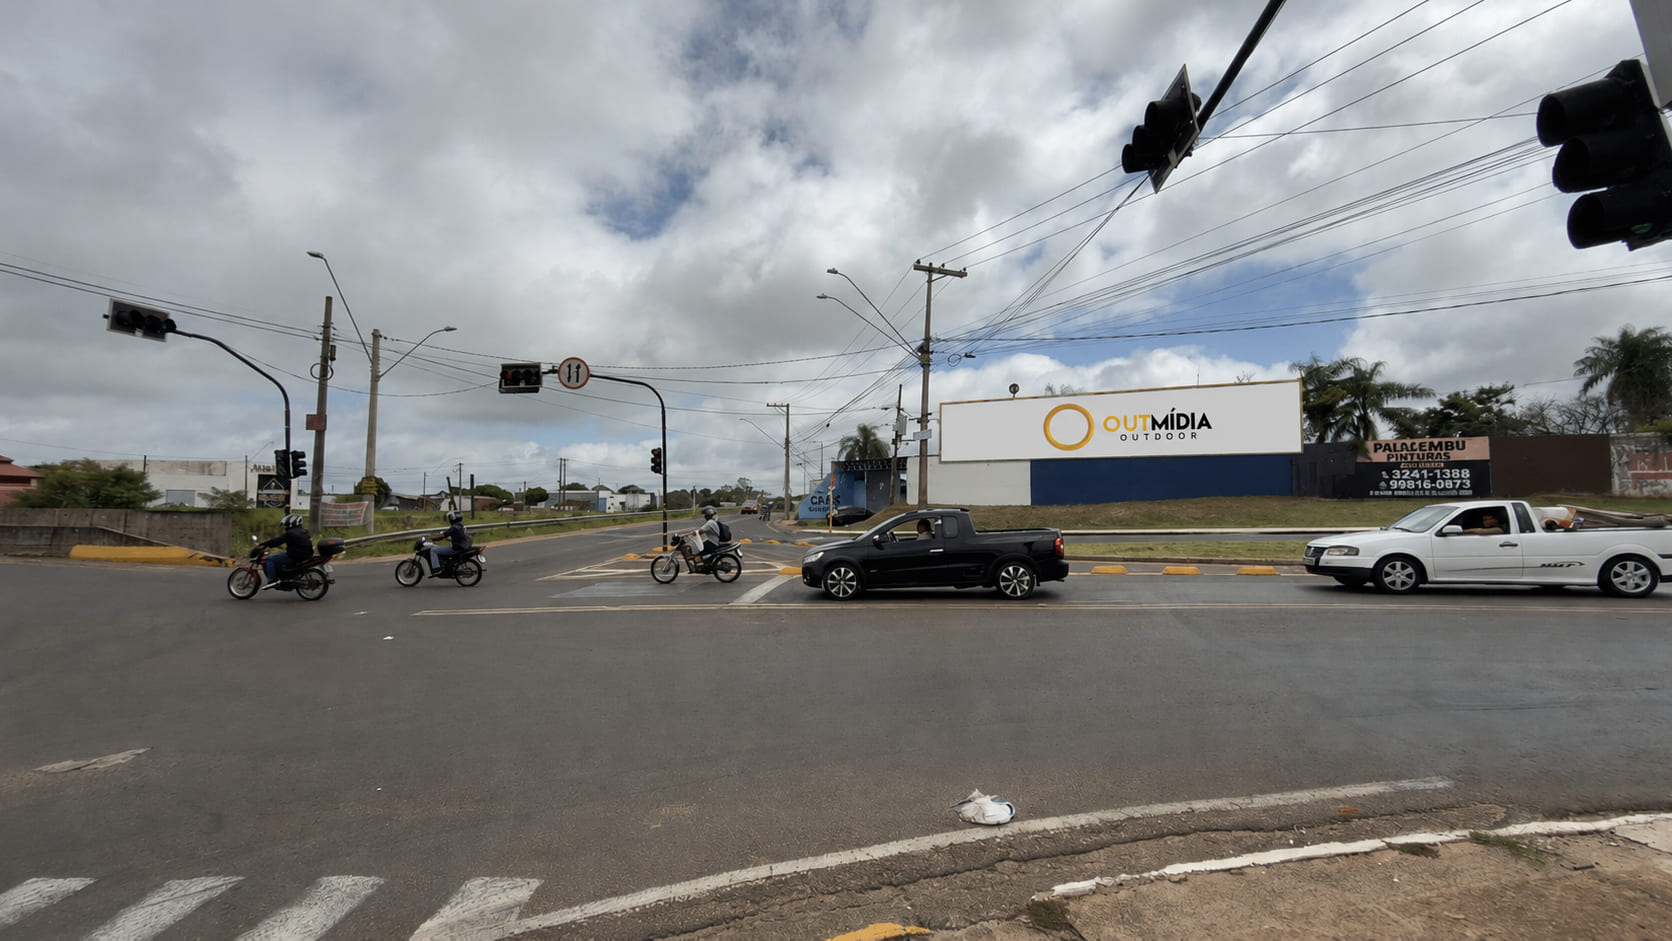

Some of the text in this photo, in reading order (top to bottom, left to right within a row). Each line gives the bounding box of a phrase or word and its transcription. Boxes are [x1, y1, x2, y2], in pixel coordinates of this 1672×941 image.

[1103, 408, 1212, 432] OUTMÍDIA
[1120, 432, 1197, 441] OUTDOOR
[1387, 452, 1450, 461] PINTURAS
[1391, 468, 1470, 479] 3241-1388
